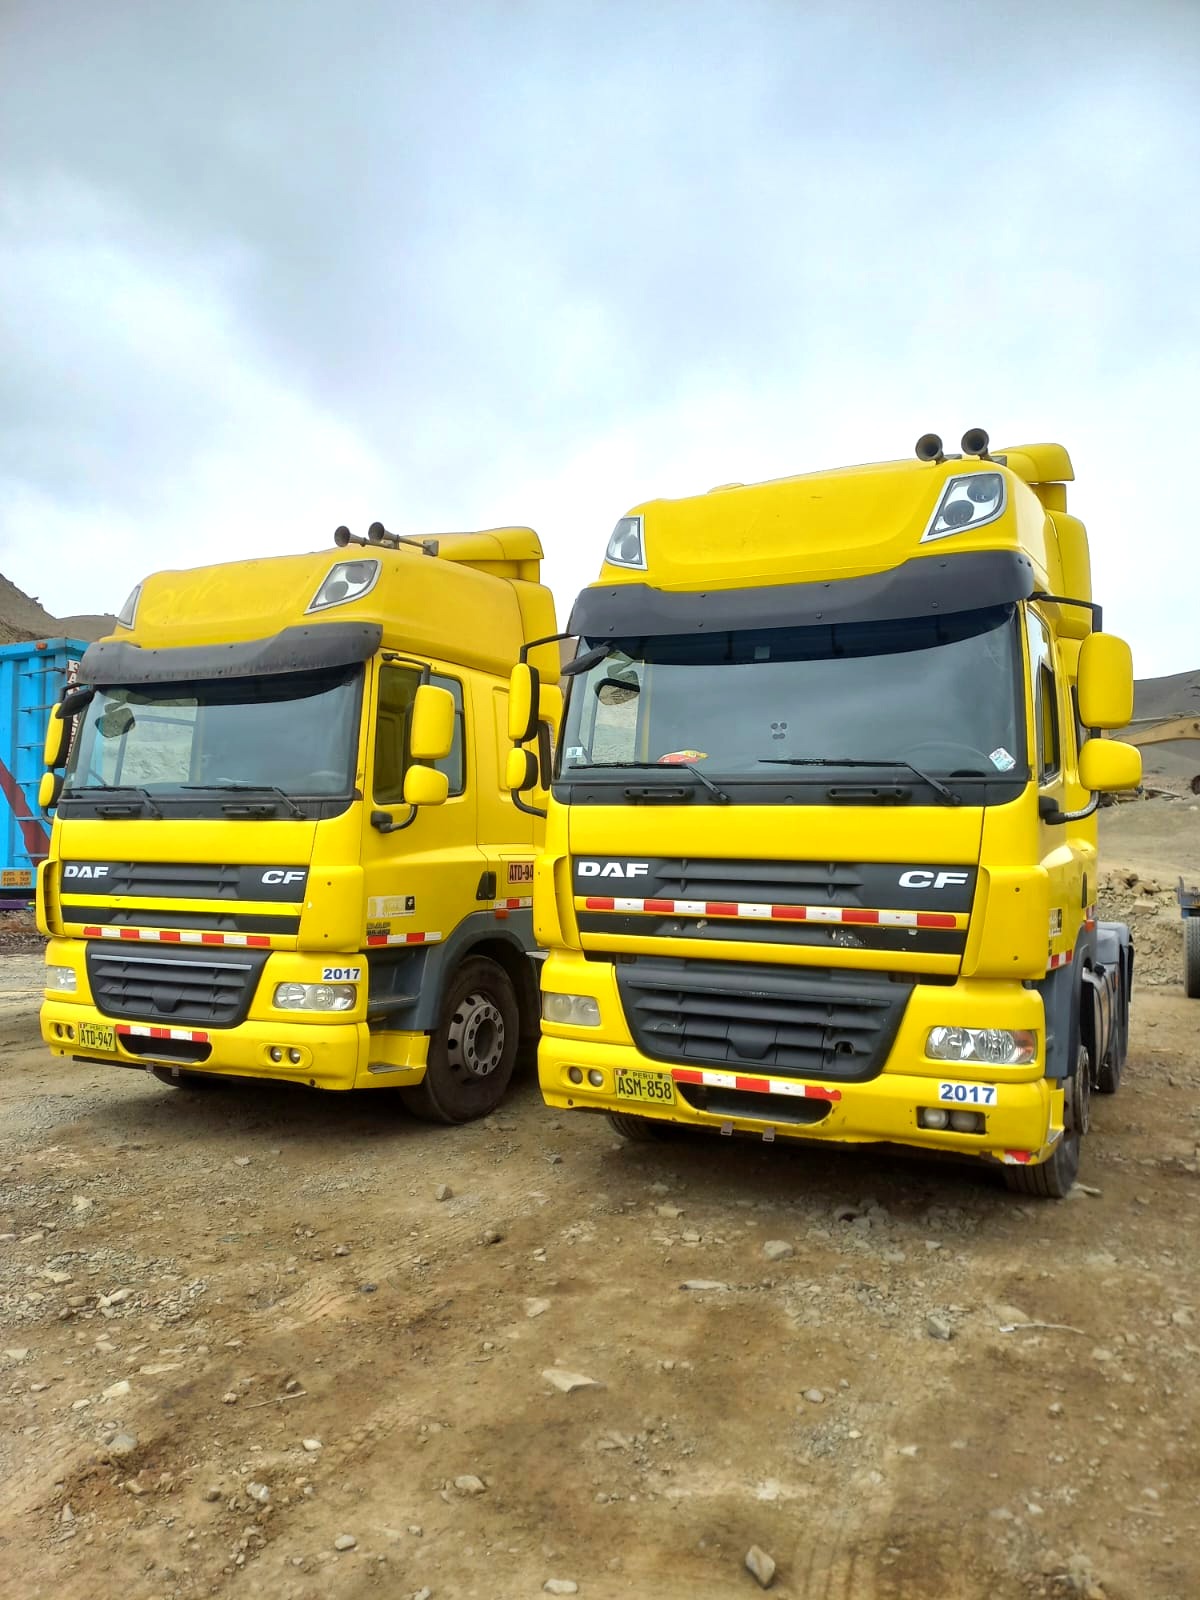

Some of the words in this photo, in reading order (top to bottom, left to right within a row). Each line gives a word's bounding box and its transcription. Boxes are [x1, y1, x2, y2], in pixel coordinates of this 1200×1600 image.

[63, 865, 109, 878] DAF
[261, 870, 306, 884] CF
[509, 864, 534, 881] ATD-94
[577, 861, 649, 878] DAF
[898, 870, 969, 889] CF
[323, 968, 361, 980] 2017
[81, 1029, 113, 1047] ATD-947
[632, 1071, 654, 1080] PERU
[618, 1076, 672, 1100] ASM-858
[940, 1083, 995, 1104] 2017
